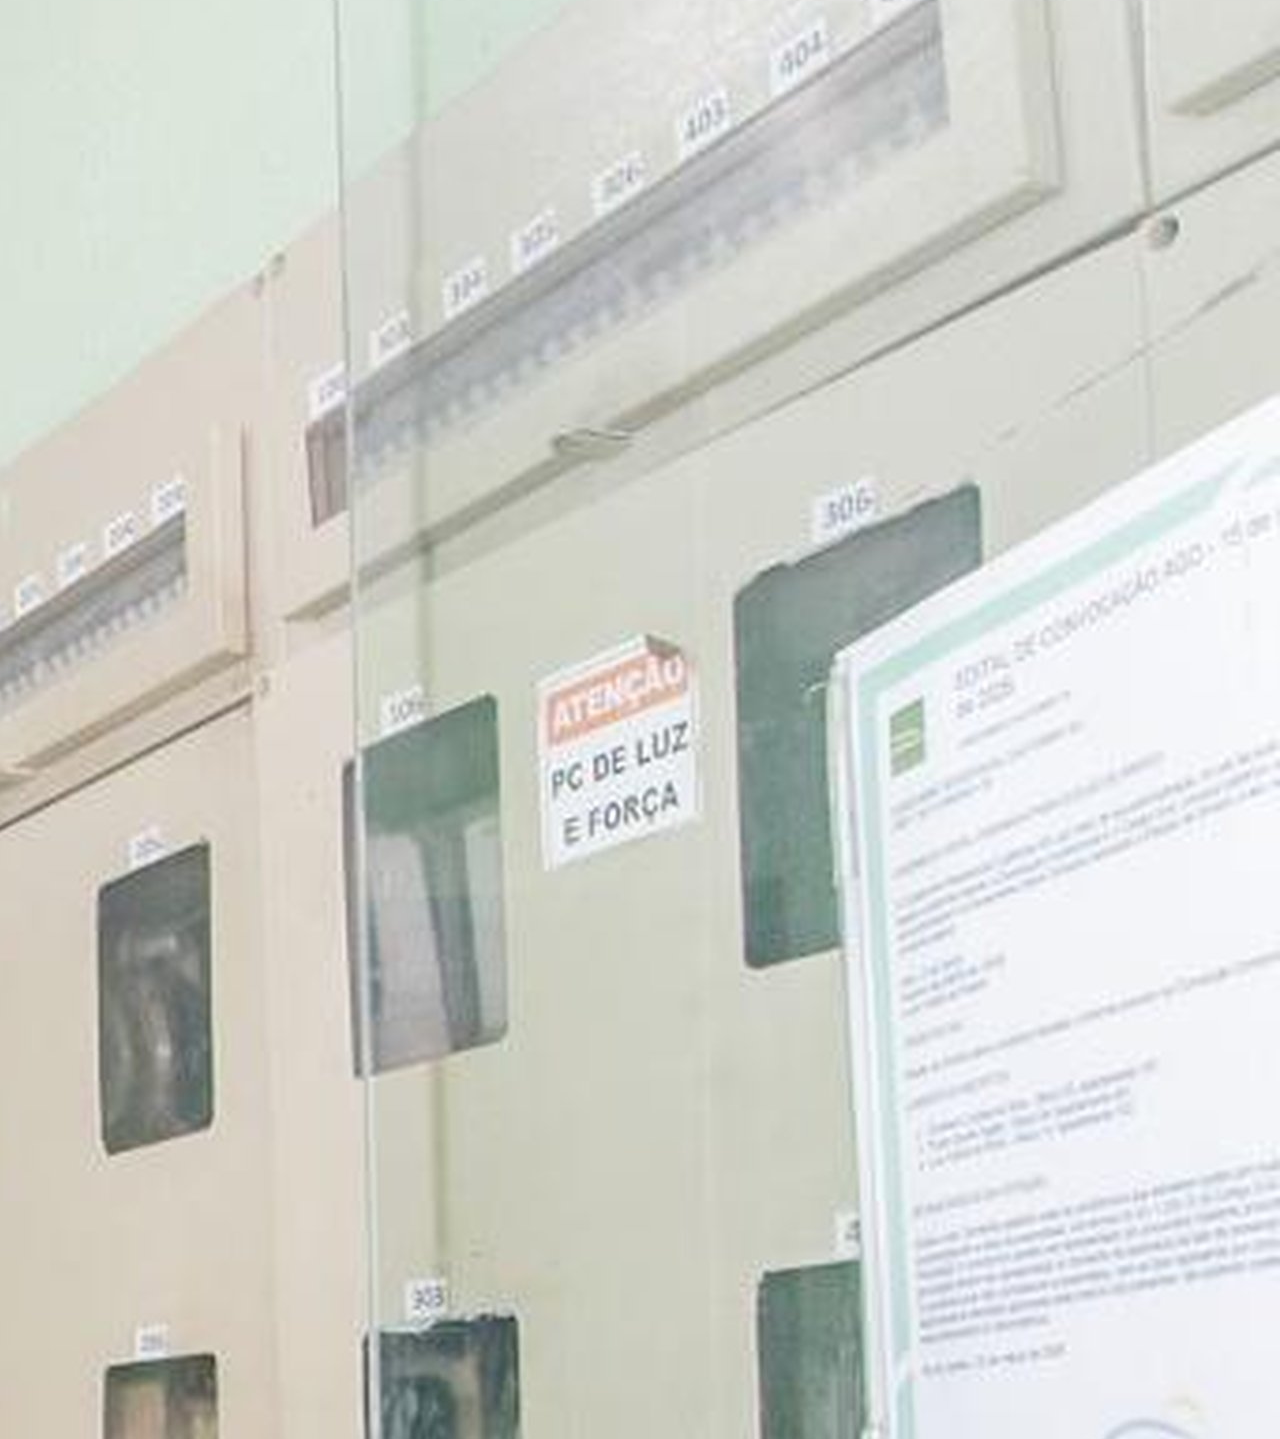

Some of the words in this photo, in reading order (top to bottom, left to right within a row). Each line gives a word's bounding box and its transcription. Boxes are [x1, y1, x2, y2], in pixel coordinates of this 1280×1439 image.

[552, 652, 686, 733] ATENÇÃO
[551, 761, 584, 800] PC
[593, 744, 626, 783] DE
[636, 719, 689, 767] LUZ
[563, 815, 581, 847] E
[588, 779, 681, 838] FORÇA
